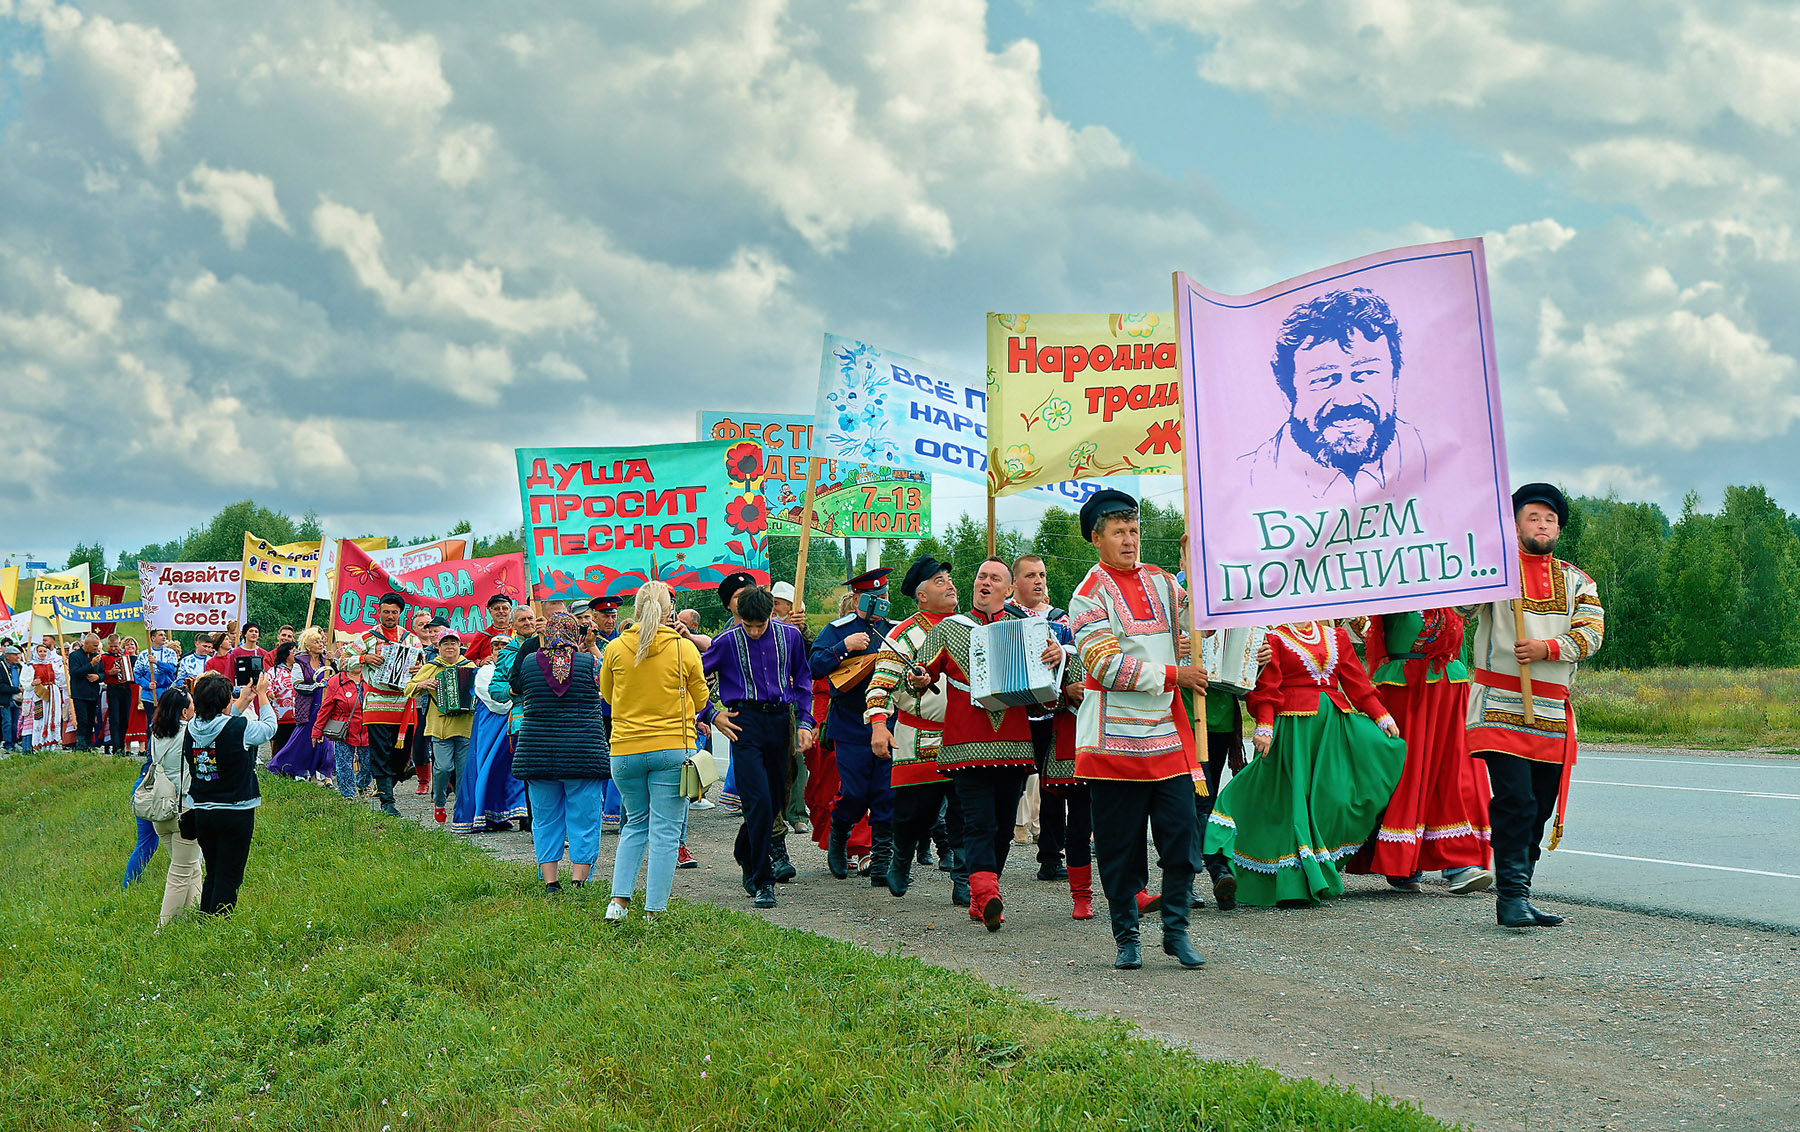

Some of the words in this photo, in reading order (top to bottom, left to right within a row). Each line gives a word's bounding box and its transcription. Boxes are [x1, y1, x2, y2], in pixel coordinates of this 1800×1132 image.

[1007, 336, 1178, 382] Народна
[890, 363, 958, 406] ВСЁ
[529, 485, 707, 524] ПРОСИТ
[852, 511, 921, 533] ИЮЛЯ
[257, 541, 267, 550] В
[249, 556, 312, 578] ФЕСТИ
[400, 553, 437, 567] ПУТЬ,
[1219, 532, 1498, 602] ПОМНИТЬ!..
[36, 579, 79, 593] Давай
[158, 565, 240, 586] Давайте
[167, 590, 237, 608] ценить
[79, 611, 102, 620] ТАК
[174, 609, 228, 626] своё!
